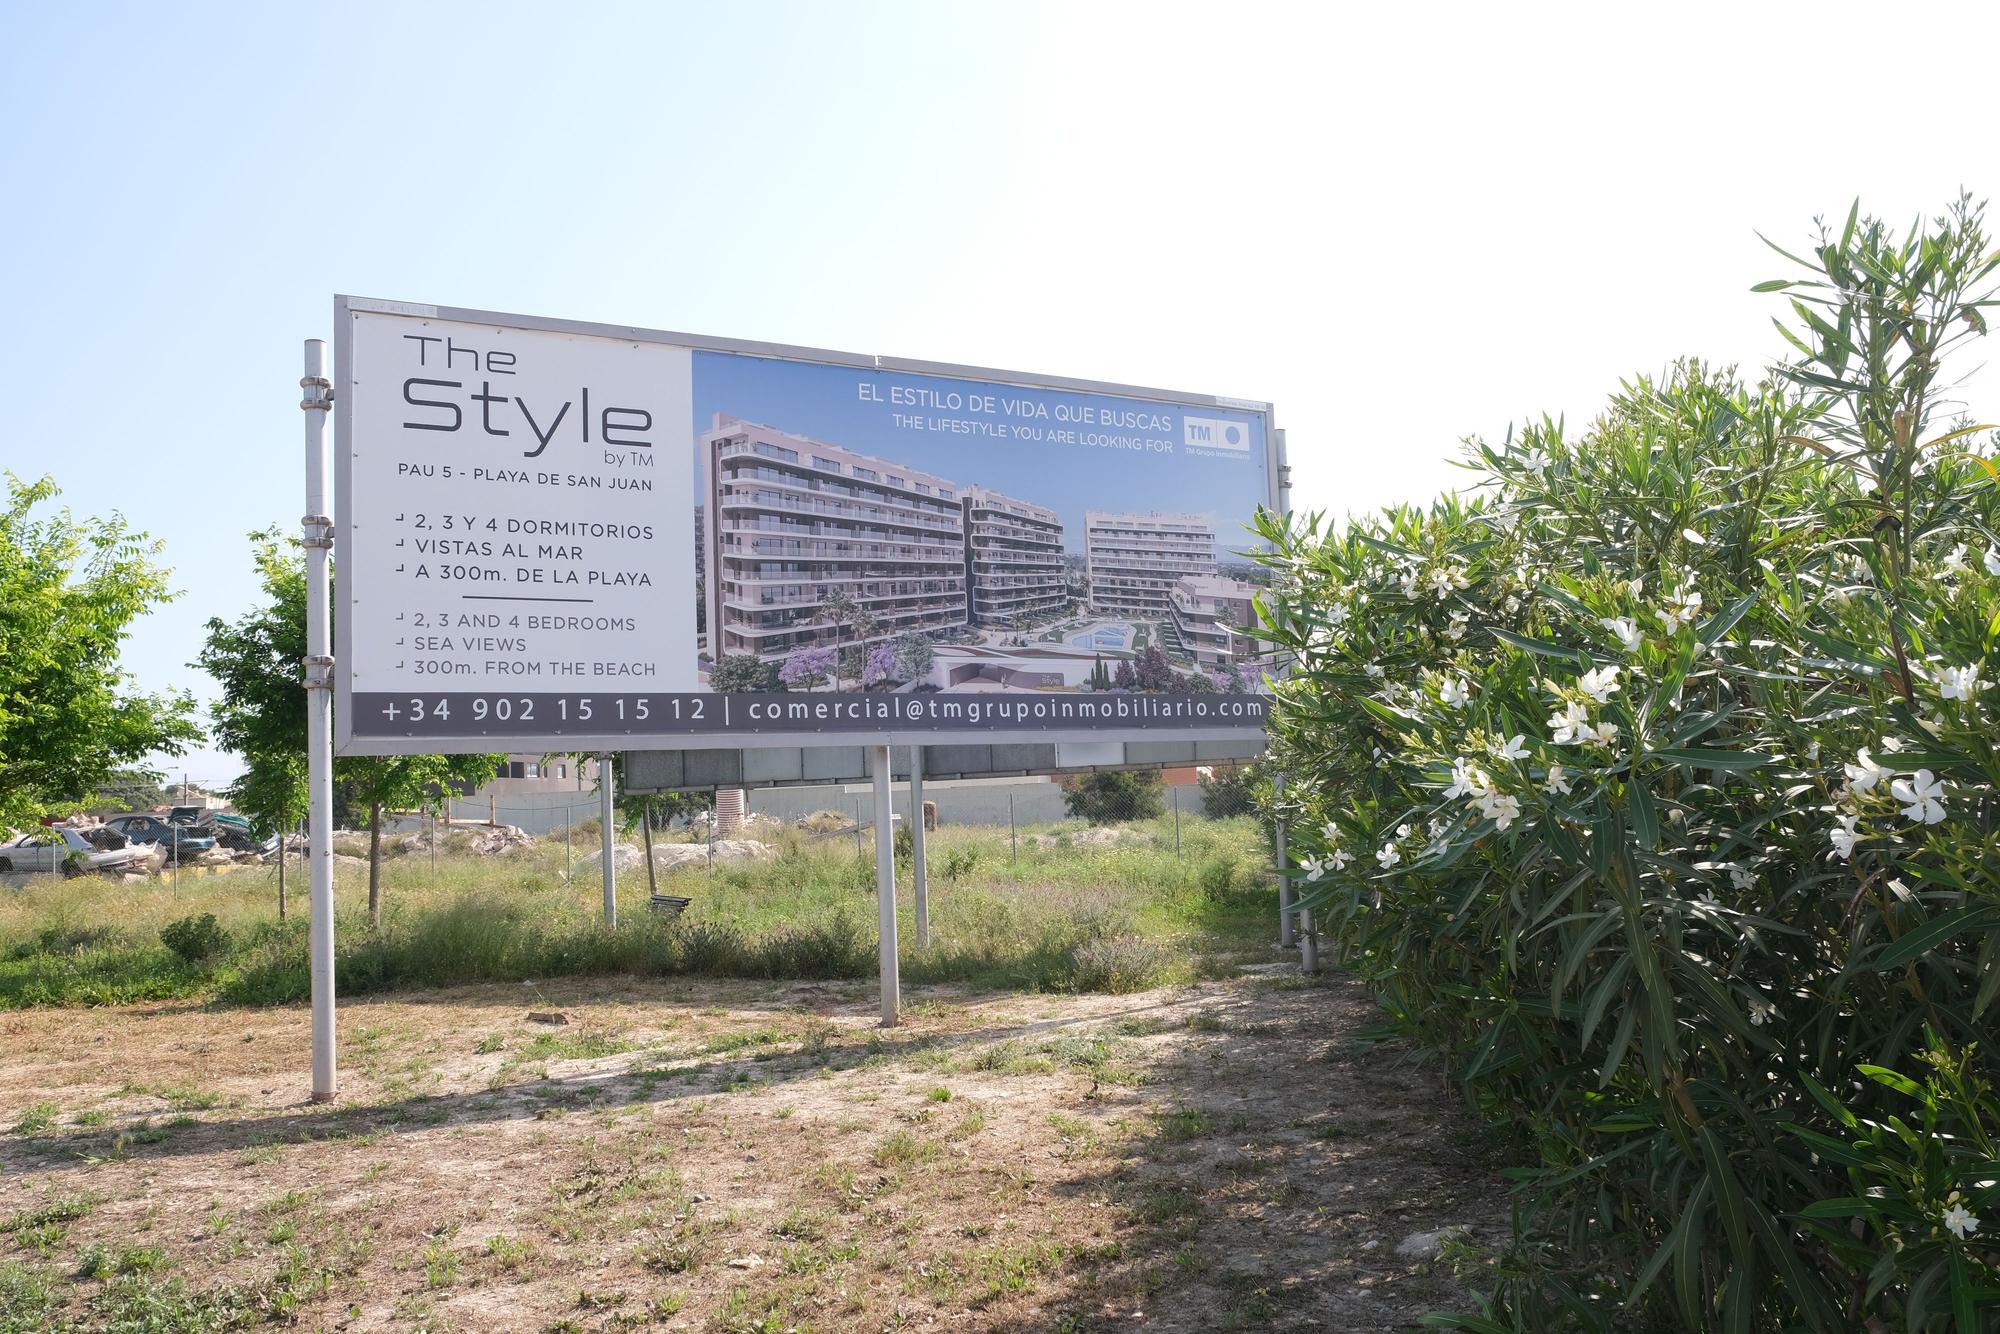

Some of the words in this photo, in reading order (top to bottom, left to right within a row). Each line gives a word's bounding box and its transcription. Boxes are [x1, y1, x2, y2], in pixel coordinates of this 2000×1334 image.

[403, 335, 516, 375] The
[403, 377, 652, 457] Style
[858, 382, 885, 402] EL
[891, 386, 962, 410] ESTILO
[969, 394, 996, 414] DE
[1002, 398, 1049, 420] VIDA
[1055, 404, 1095, 424] QUE
[1100, 409, 1172, 432] BUSCAS
[892, 413, 924, 430] THE
[928, 417, 1007, 438] LIFESTYLE
[1011, 425, 1042, 441] YOU
[1046, 429, 1076, 444] ARE
[1079, 432, 1142, 450] LOOKING
[1146, 440, 1173, 454] FOR
[1188, 424, 1211, 441] TM
[604, 450, 625, 468] by
[630, 452, 654, 468] TM
[398, 462, 435, 478] PAU
[442, 465, 452, 479] 5
[473, 468, 530, 484] PLAYA
[537, 472, 561, 486] DE
[567, 475, 601, 489] SAN
[607, 478, 652, 492] JUAN
[414, 513, 433, 531] 2,
[442, 514, 454, 530] 3
[463, 516, 476, 531] Y
[485, 517, 498, 533] 4
[507, 518, 654, 540] DORMITORIOS
[415, 539, 493, 557] VISTAS
[502, 543, 529, 558] AL
[538, 544, 583, 561] MAR
[415, 564, 430, 579] A
[439, 564, 507, 582] 300m.
[517, 567, 544, 583] DE
[553, 569, 579, 585] LA
[588, 570, 653, 587] PLAYA
[413, 612, 431, 629] 2,
[438, 613, 449, 628] 3
[457, 614, 501, 629] AND
[508, 615, 520, 629] 4
[527, 615, 636, 632] BEDROOMS
[414, 636, 455, 651] SEA
[462, 637, 527, 652] VIEWS
[414, 660, 477, 675] 300m.
[485, 660, 541, 676] FROM
[548, 661, 586, 676] THE
[592, 662, 656, 677] BEACH
[381, 698, 451, 722] +34
[472, 698, 535, 721] 902
[557, 698, 593, 720] 15
[615, 698, 650, 720] 15
[671, 698, 705, 720] 12
[748, 697, 1263, 723] comercial@tmgrupoinmobiliario.com
